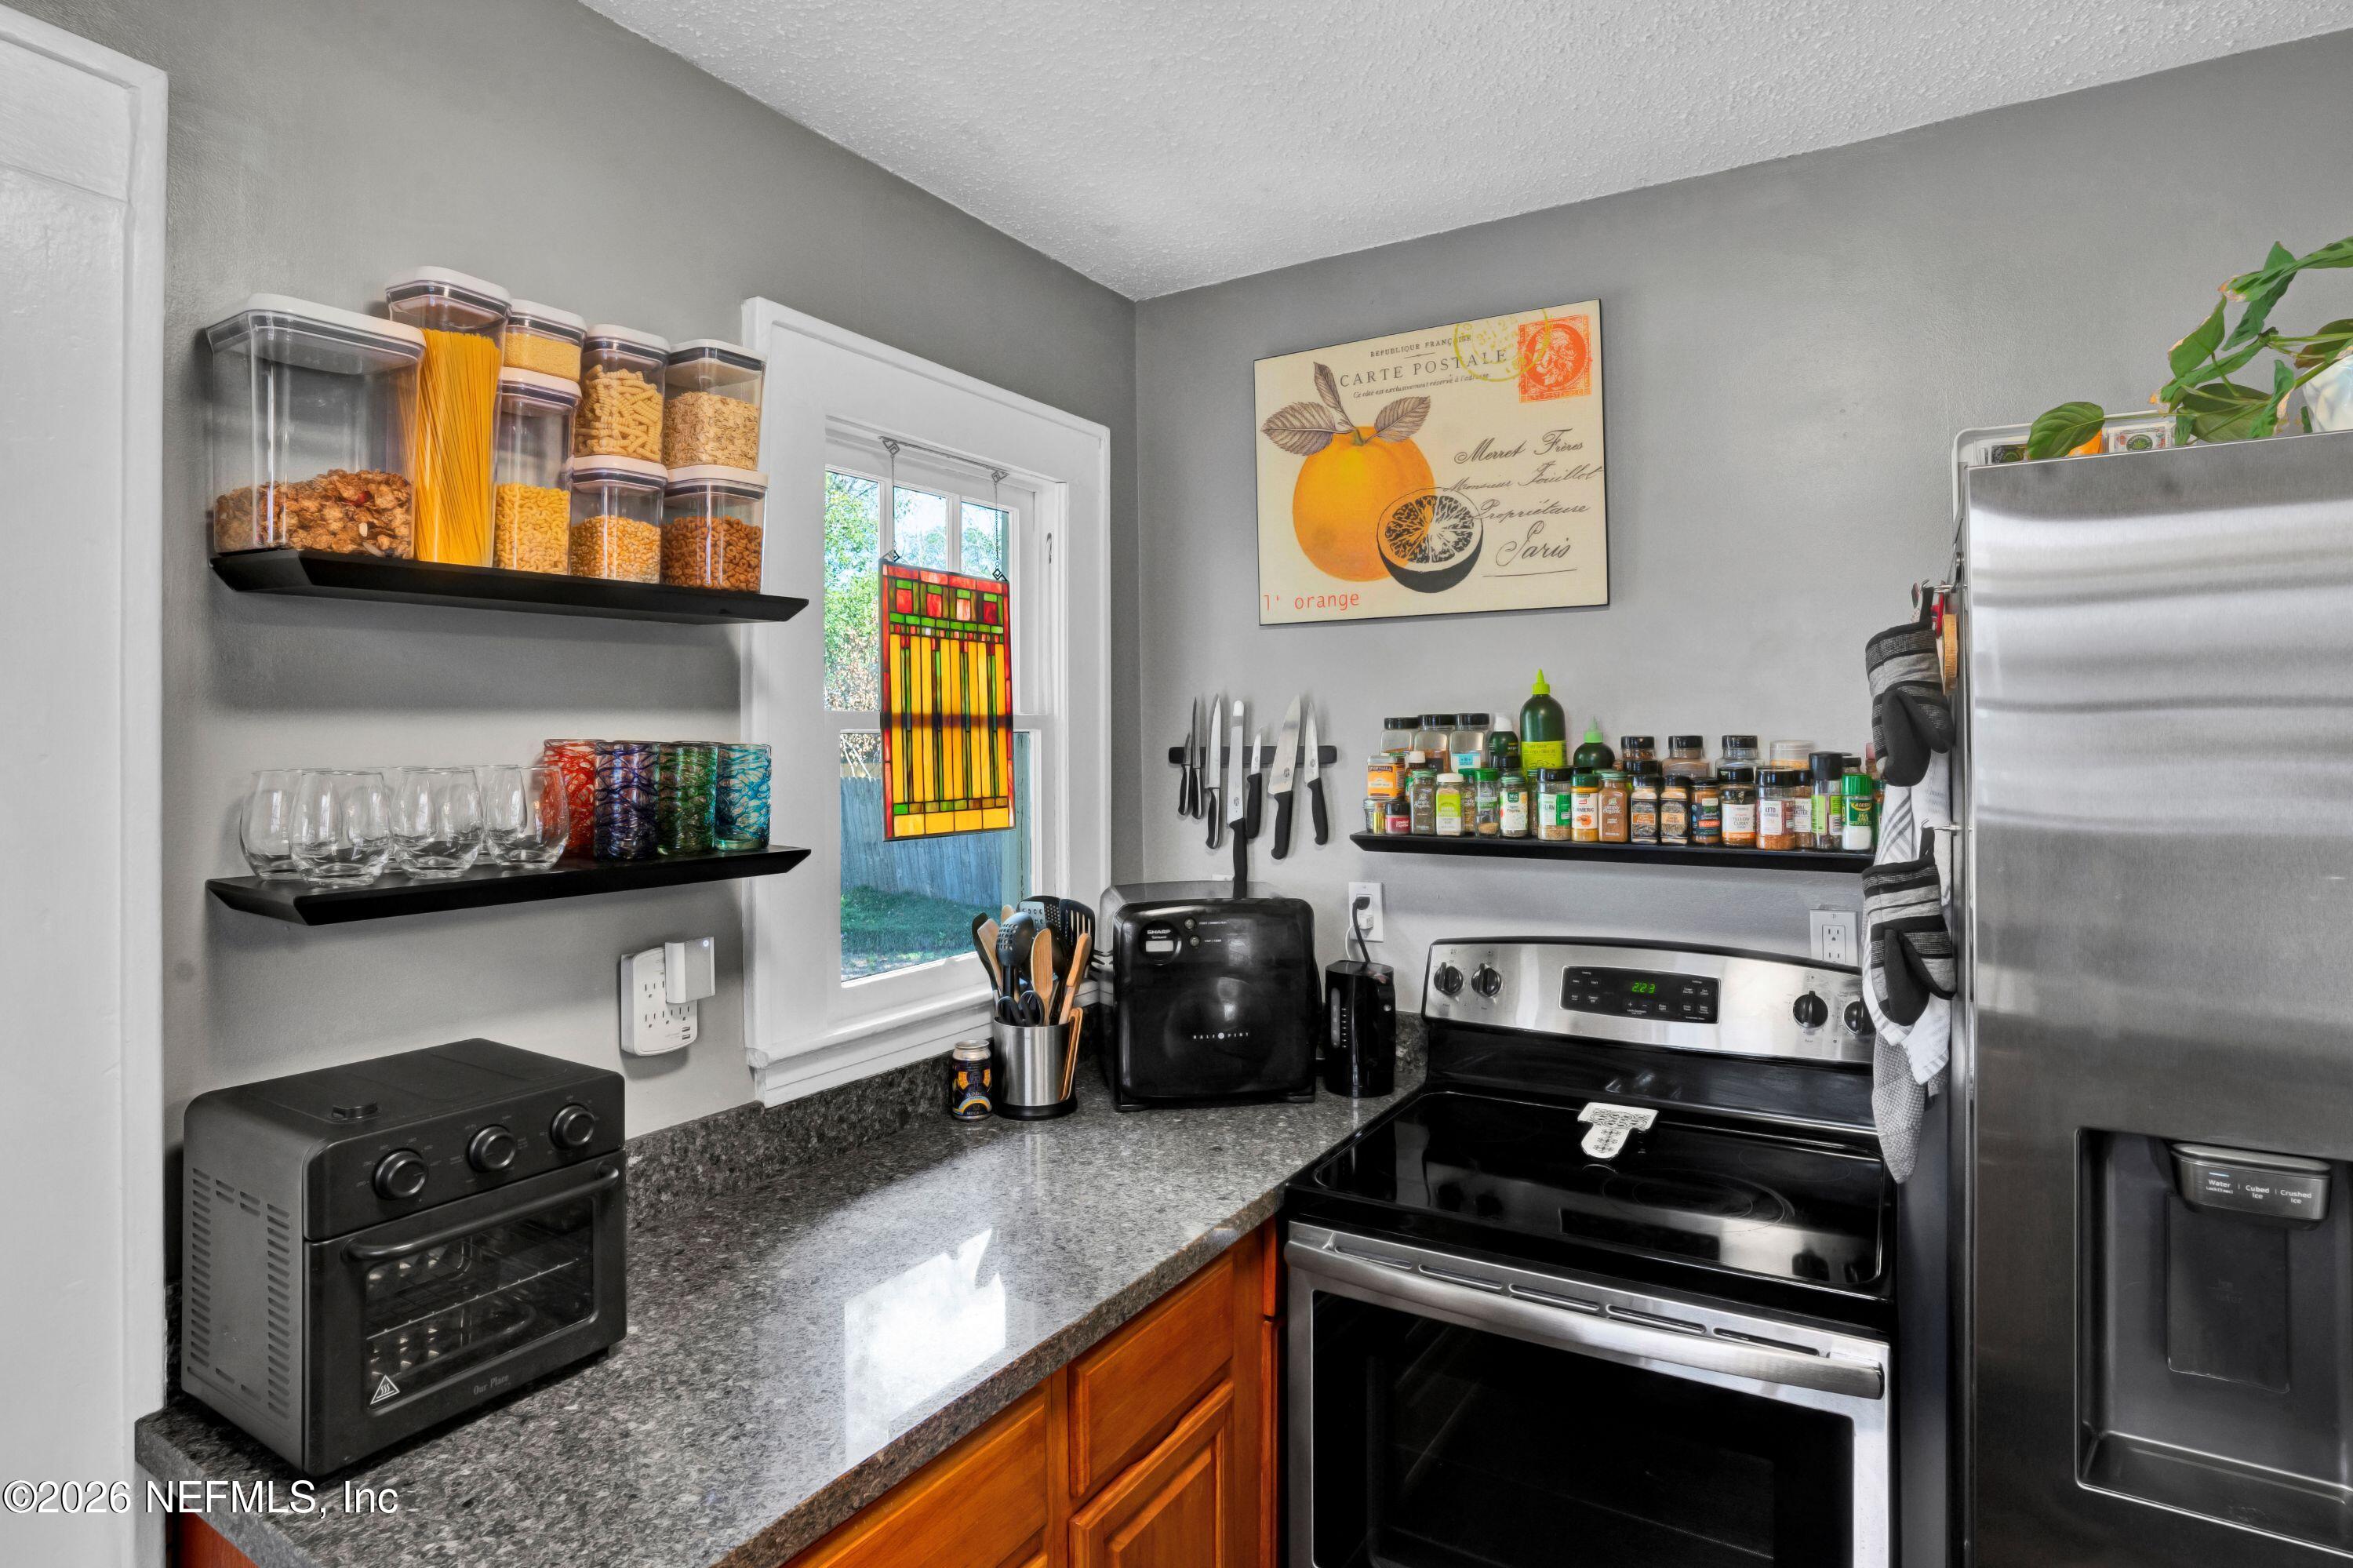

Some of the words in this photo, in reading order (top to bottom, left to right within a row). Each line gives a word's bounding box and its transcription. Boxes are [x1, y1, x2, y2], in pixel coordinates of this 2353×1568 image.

[1340, 366, 1404, 387] CARTE
[1413, 349, 1507, 375] POSTALE
[1495, 520, 1572, 567] Paris
[1294, 593, 1360, 611] orange
[1631, 982, 1656, 994] 2:23
[2208, 1179, 2231, 1188] Water
[2245, 1184, 2270, 1194] Cubed
[2280, 1189, 2312, 1199] Crushed
[473, 1384, 489, 1395] Our
